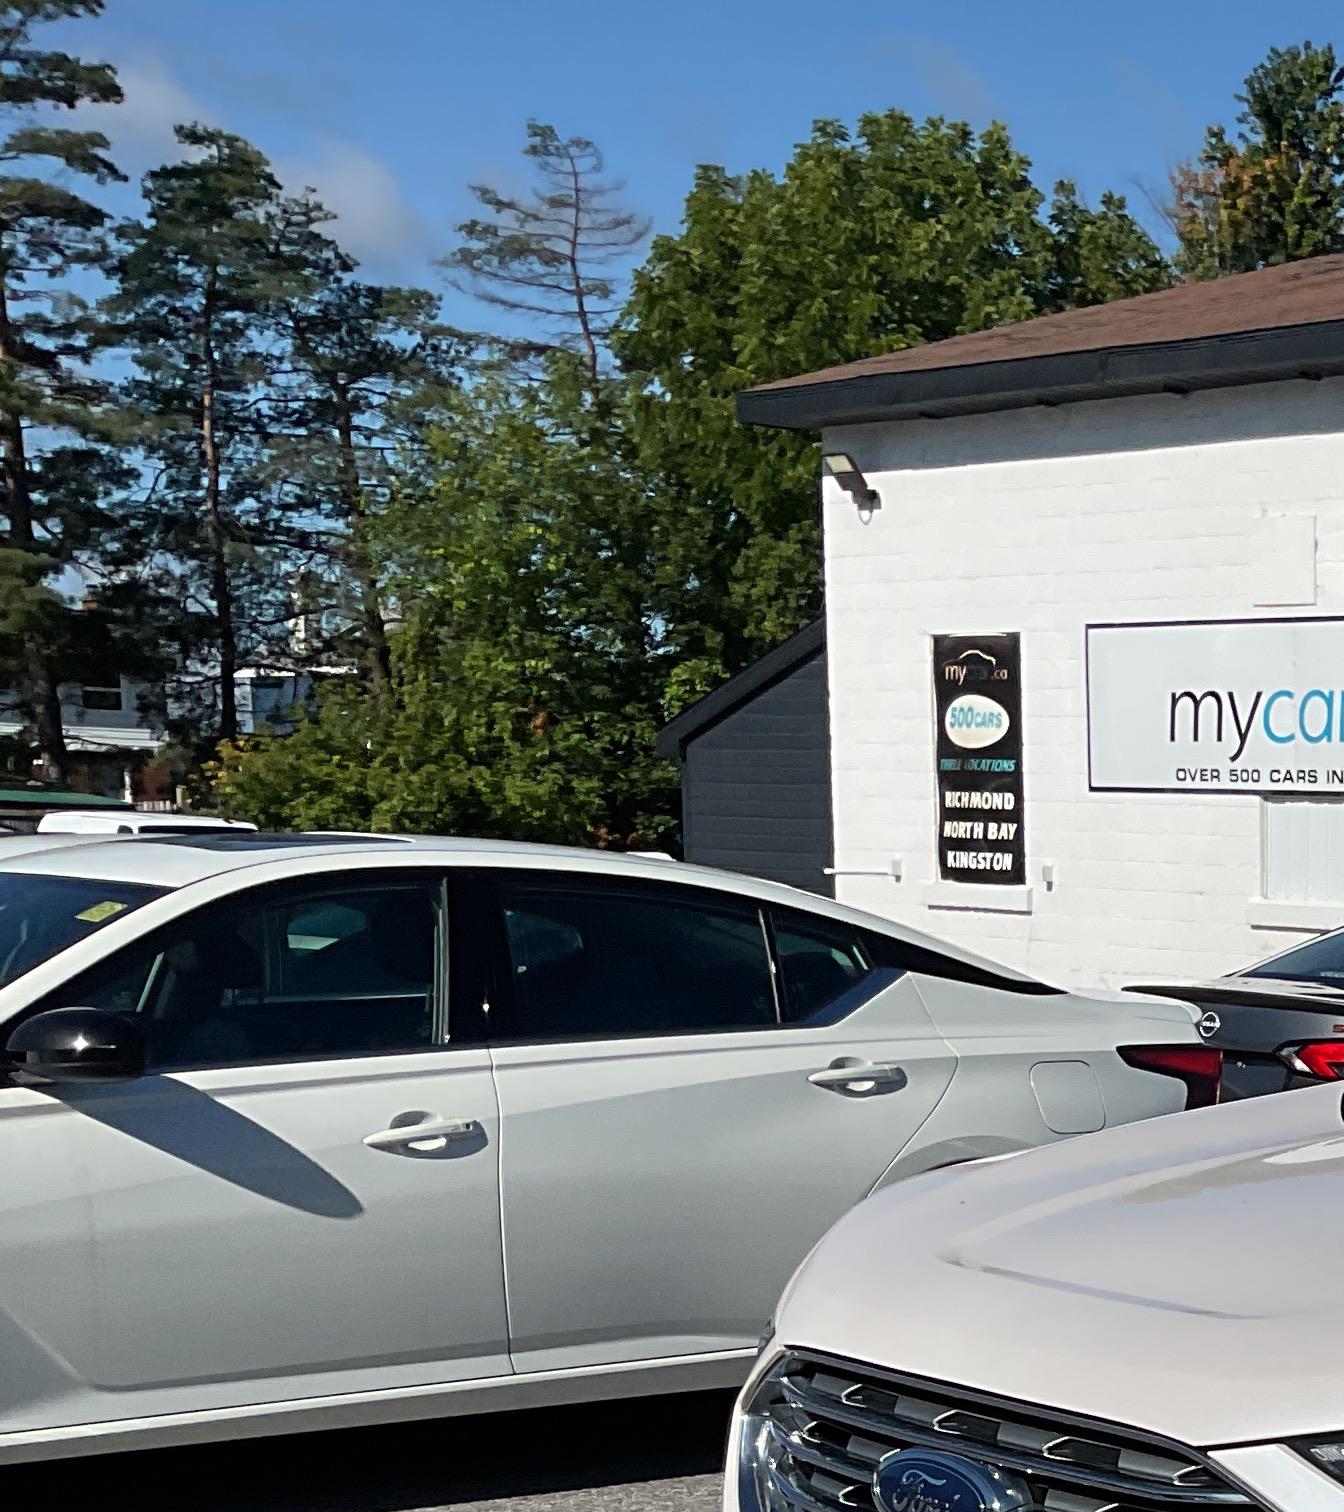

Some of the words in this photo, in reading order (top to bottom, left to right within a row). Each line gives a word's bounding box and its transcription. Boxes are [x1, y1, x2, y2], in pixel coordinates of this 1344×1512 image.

[1176, 768, 1221, 783] OVER
[1229, 768, 1261, 784] 500
[1269, 769, 1319, 784] CARS
[1326, 770, 1344, 785] IN
[945, 791, 1015, 811] RICHMOND
[943, 821, 984, 839] NORTH
[987, 822, 1018, 841] BAY
[947, 850, 1013, 871] KINGSTON
